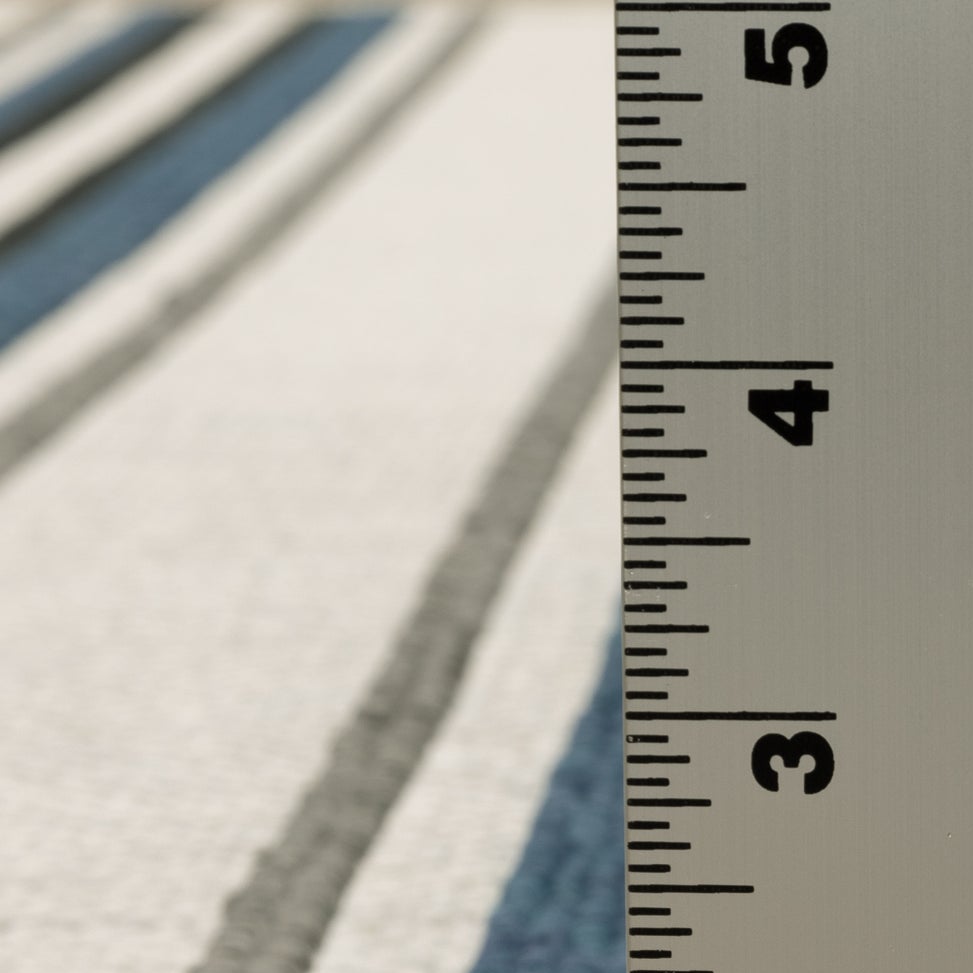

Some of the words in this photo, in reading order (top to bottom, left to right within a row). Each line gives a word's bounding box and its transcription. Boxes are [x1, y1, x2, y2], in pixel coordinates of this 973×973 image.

[744, 23, 828, 89] 5
[748, 380, 829, 446] 4
[751, 731, 835, 794] 3
